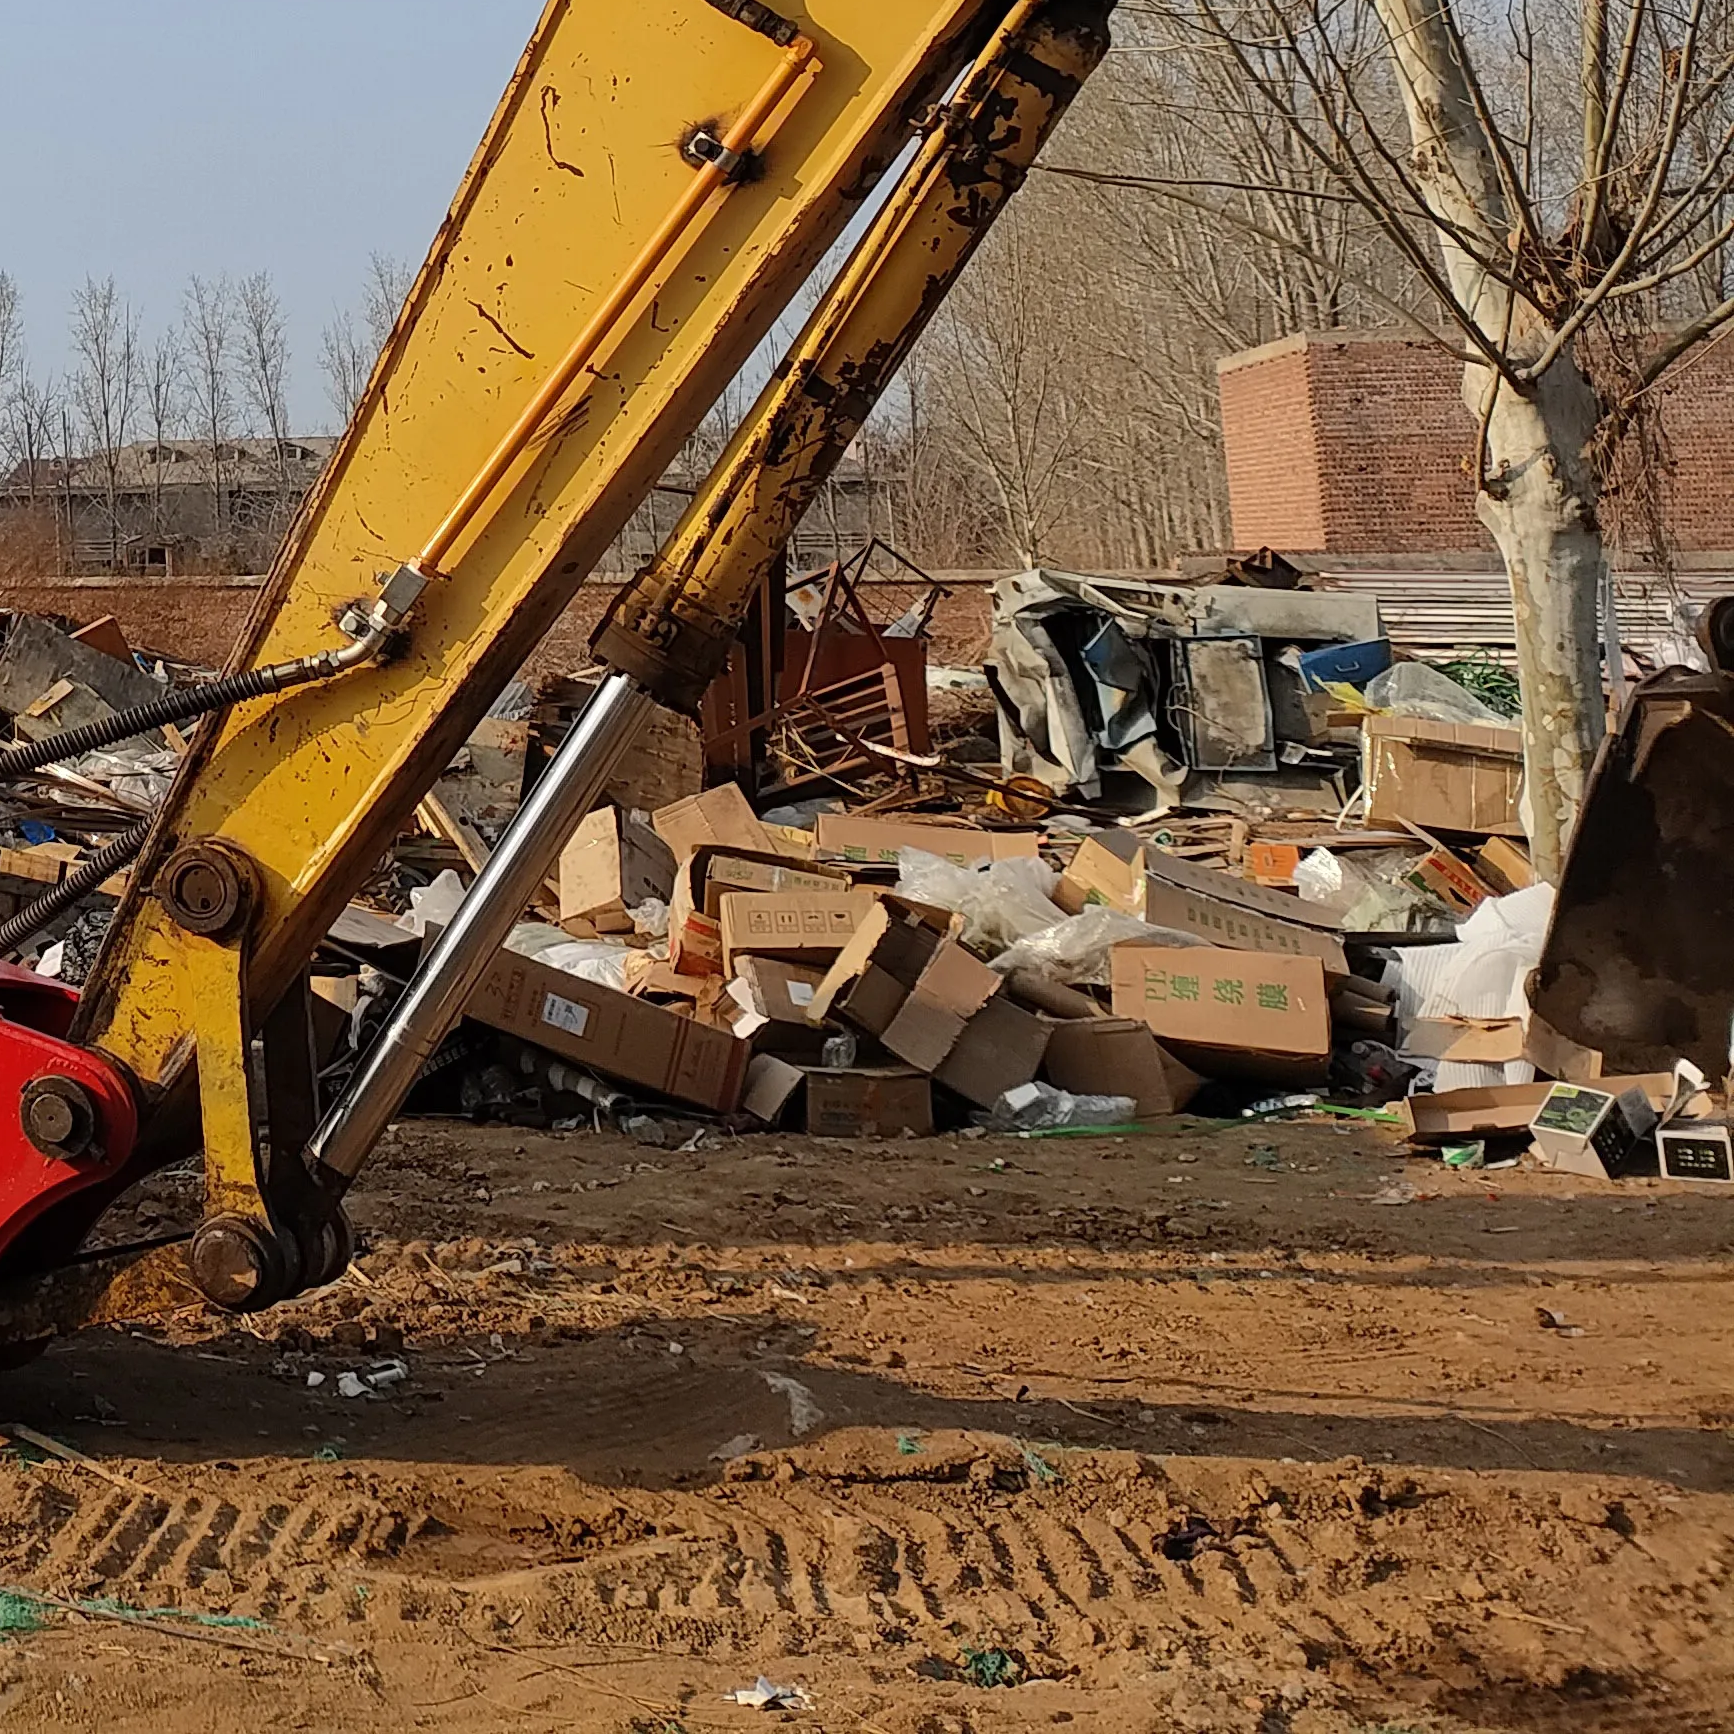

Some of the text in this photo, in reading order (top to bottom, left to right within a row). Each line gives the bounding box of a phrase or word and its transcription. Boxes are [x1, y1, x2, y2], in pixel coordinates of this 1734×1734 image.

[1144, 968, 1167, 1002] PE
[1169, 974, 1289, 1011] 缠绕膜
